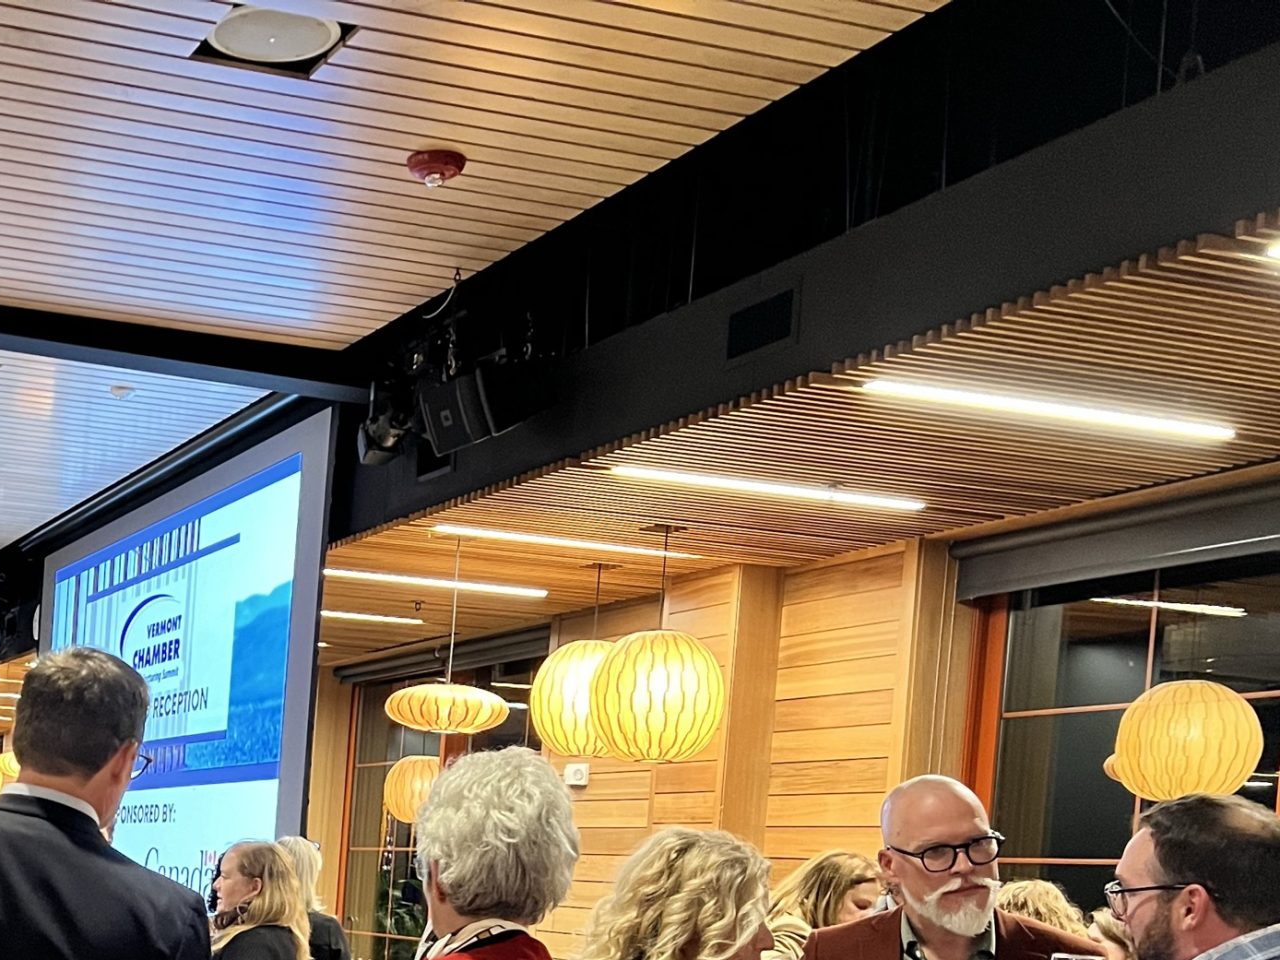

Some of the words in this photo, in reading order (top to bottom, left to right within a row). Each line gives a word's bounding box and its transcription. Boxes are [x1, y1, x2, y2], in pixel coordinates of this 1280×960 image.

[147, 614, 182, 639] VERMONT
[133, 638, 180, 669] CHAMBER
[153, 687, 209, 718] RECEPTION
[117, 804, 160, 824] ONSORED
[162, 803, 176, 823] BY:
